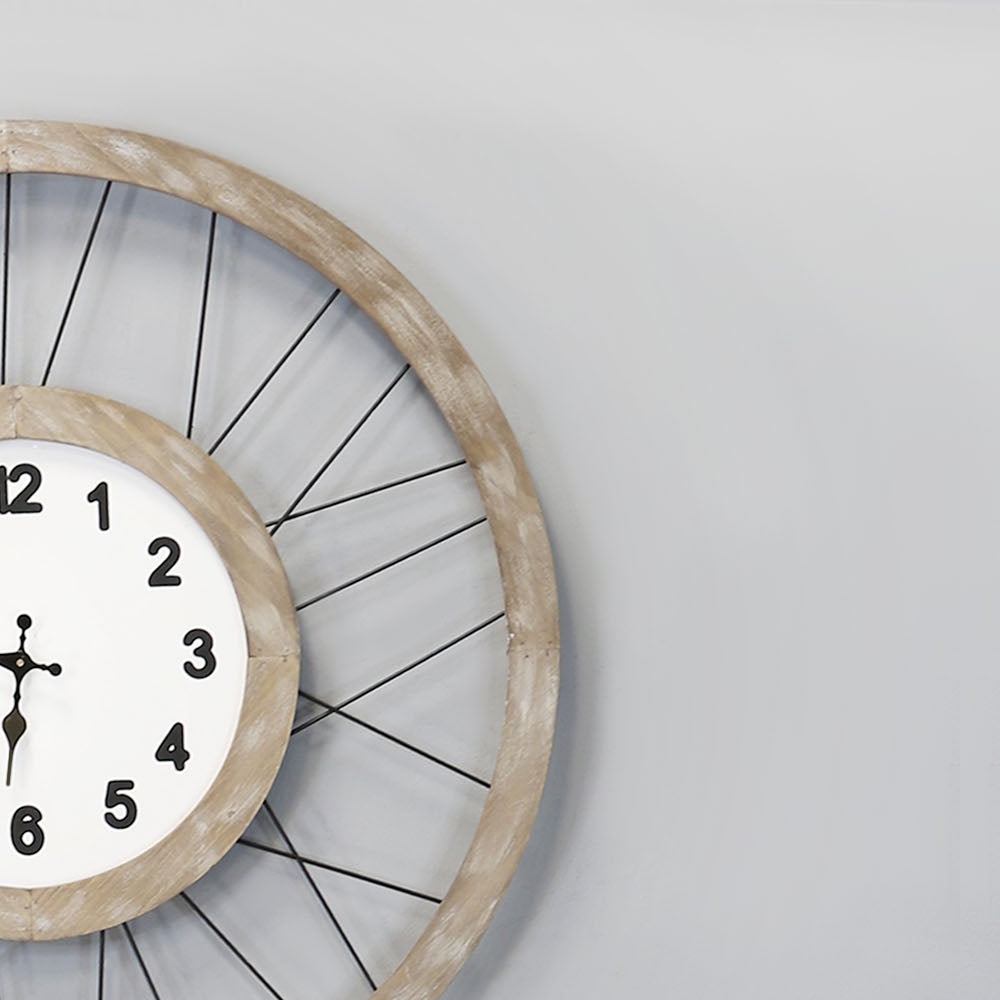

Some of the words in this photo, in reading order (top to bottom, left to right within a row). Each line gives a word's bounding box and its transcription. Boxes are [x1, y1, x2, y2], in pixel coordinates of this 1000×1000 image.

[87, 482, 109, 531] 1
[148, 537, 181, 587] 2
[183, 629, 216, 679] 3
[155, 723, 190, 771] 4
[105, 780, 137, 829] 5
[11, 806, 44, 856] 6
